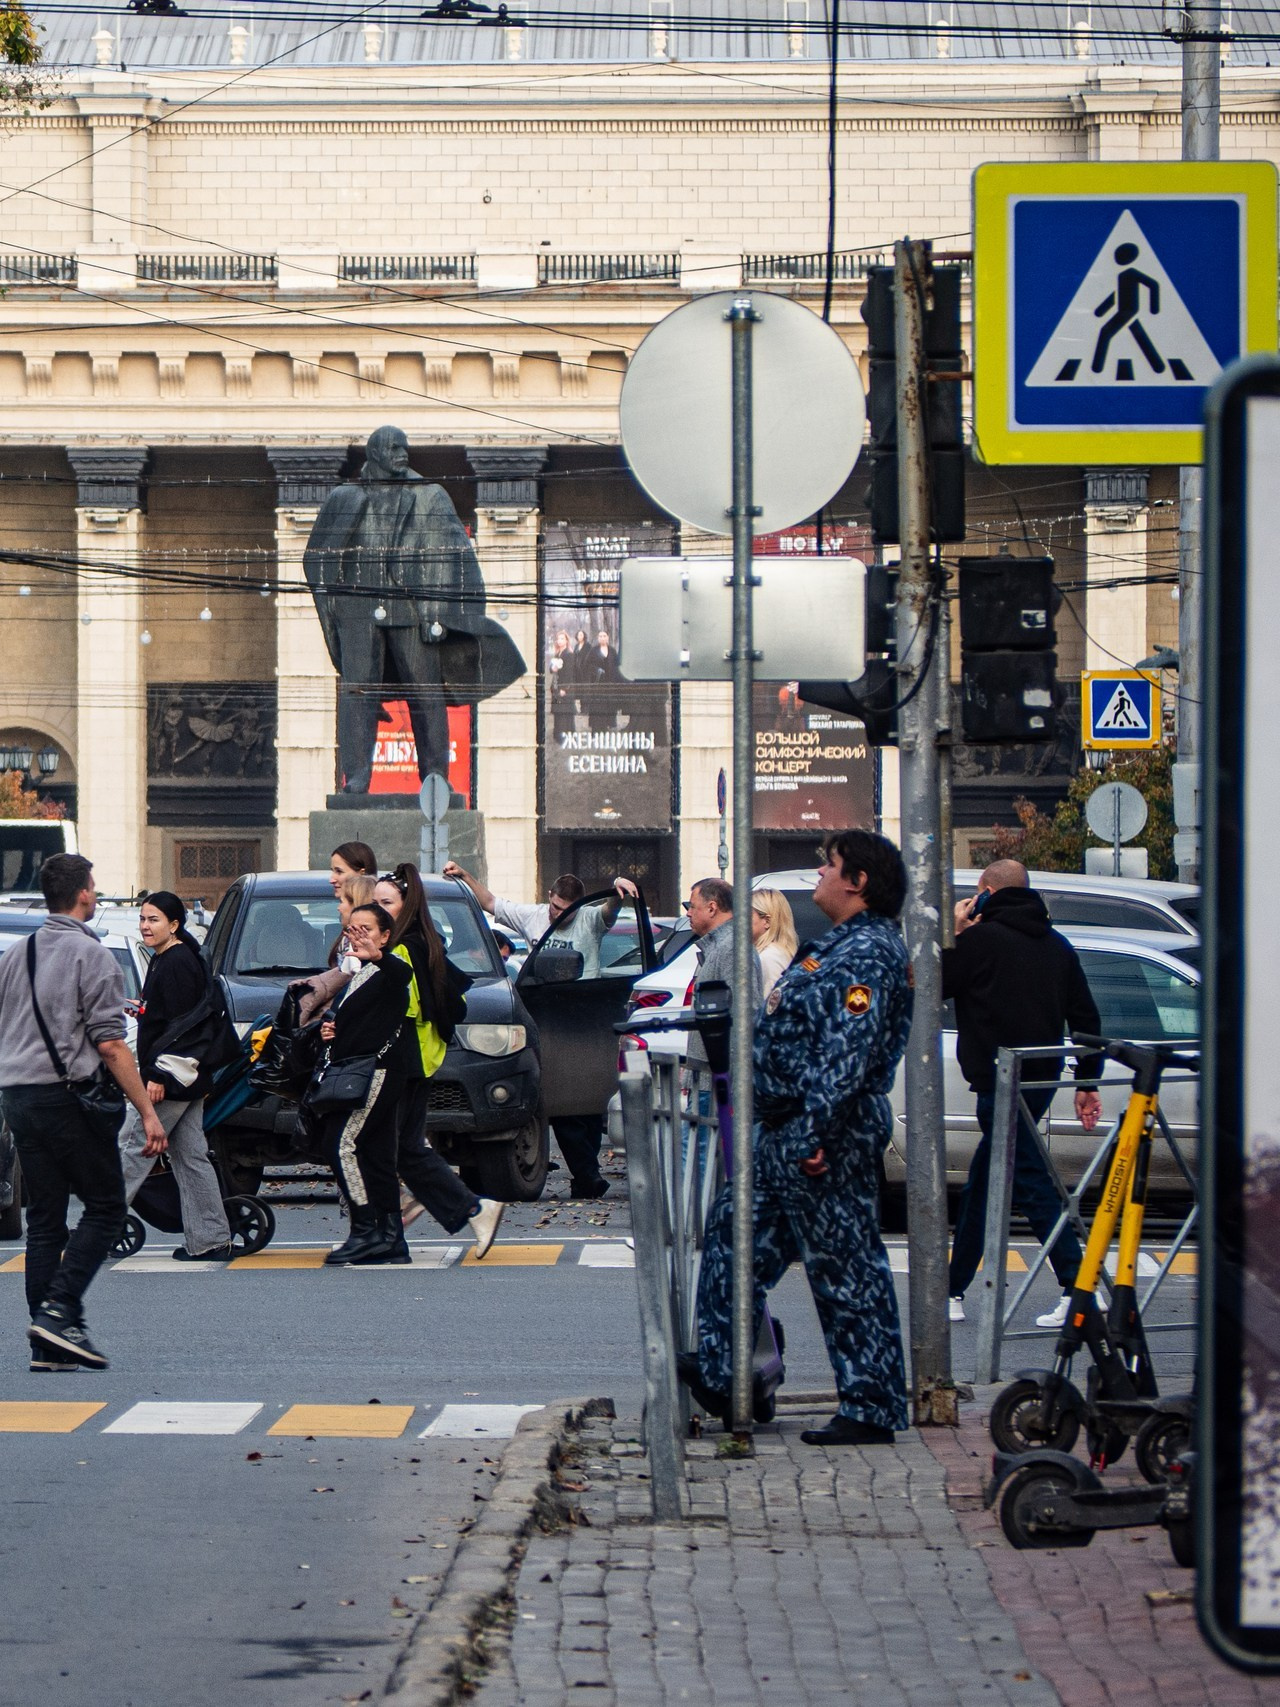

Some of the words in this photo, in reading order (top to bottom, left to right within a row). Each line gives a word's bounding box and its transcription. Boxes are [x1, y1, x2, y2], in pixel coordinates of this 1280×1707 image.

[562, 731, 655, 752] ЖЕНЩИНЫ
[756, 731, 820, 745] БОЛЬШОЙ
[756, 744, 866, 759] СИМФОНИЧЕСКИЙ
[569, 755, 647, 773] ЕСЕНИНА
[755, 760, 812, 774] КОНЦЕРТ
[1104, 1158, 1127, 1213] WHOOSH
